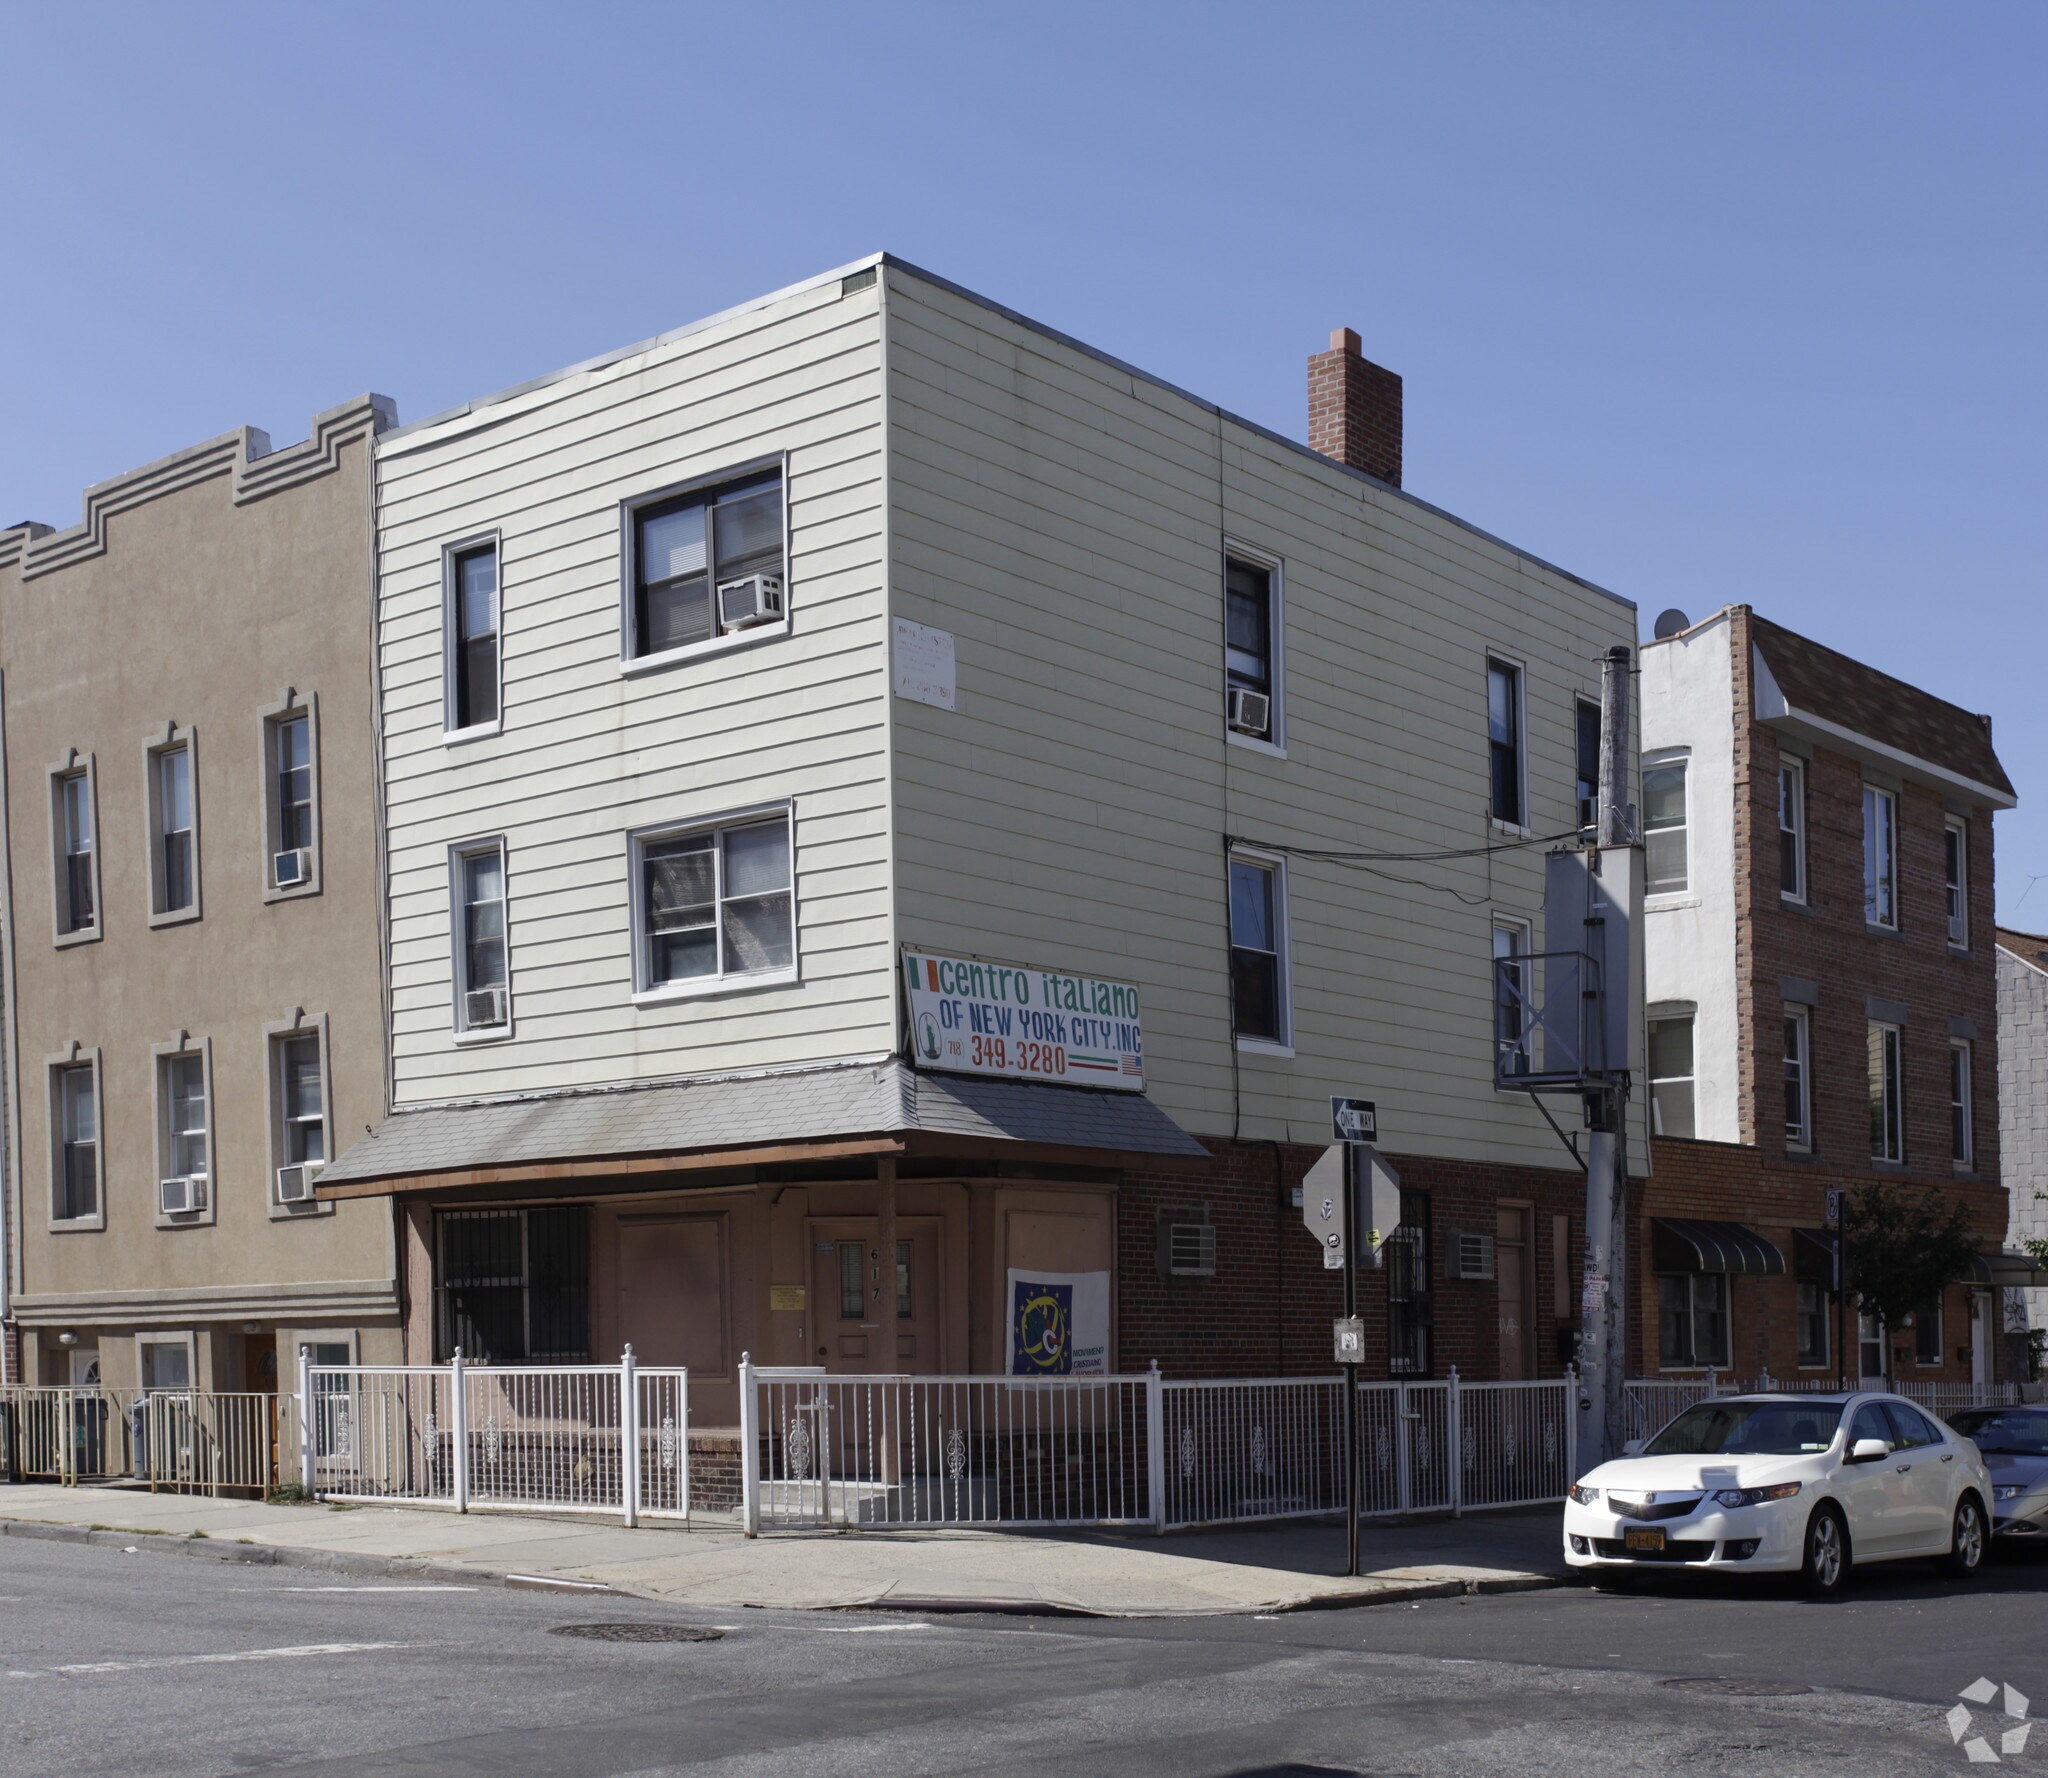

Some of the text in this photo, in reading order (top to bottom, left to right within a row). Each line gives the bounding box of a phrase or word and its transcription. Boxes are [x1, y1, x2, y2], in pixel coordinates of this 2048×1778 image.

[939, 999, 963, 1030] OF
[969, 1002, 1012, 1037] NEW
[1018, 1009, 1067, 1044] YORK
[971, 1035, 1066, 1075] 349-3280
[1341, 1111, 1372, 1129] ONE WAY
